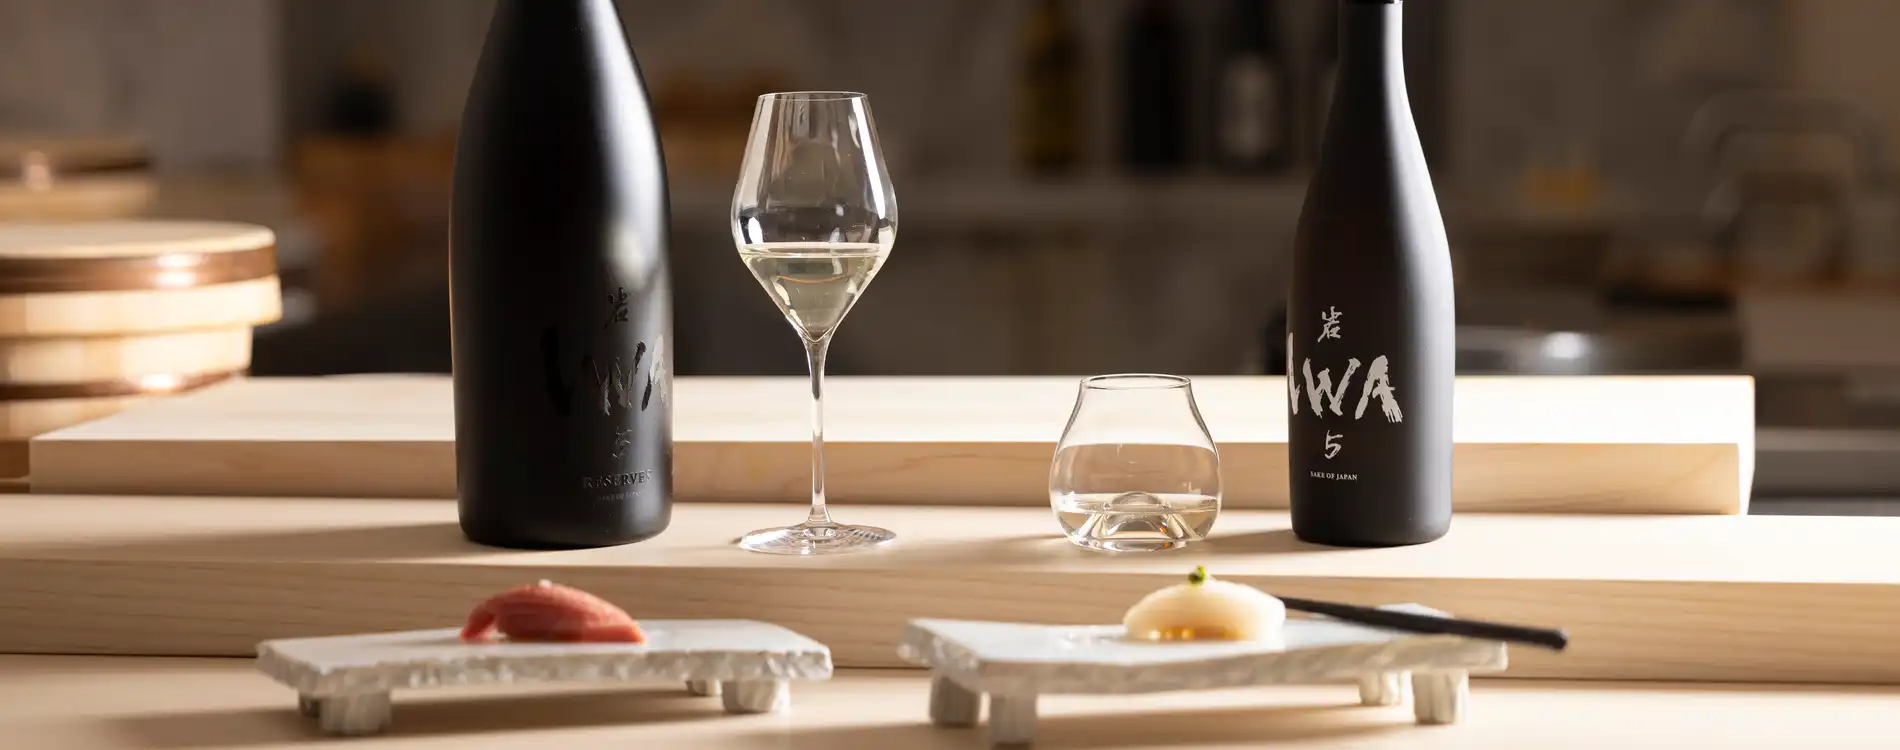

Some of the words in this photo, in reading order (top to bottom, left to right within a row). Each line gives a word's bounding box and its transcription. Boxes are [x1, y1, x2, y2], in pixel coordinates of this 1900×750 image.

[1317, 306, 1343, 343] 岩
[1287, 332, 1403, 423] IWA
[1324, 429, 1344, 460] 5
[1310, 470, 1325, 479] SAKE
[1326, 472, 1335, 480] OF
[1336, 473, 1358, 482] JAPAN
